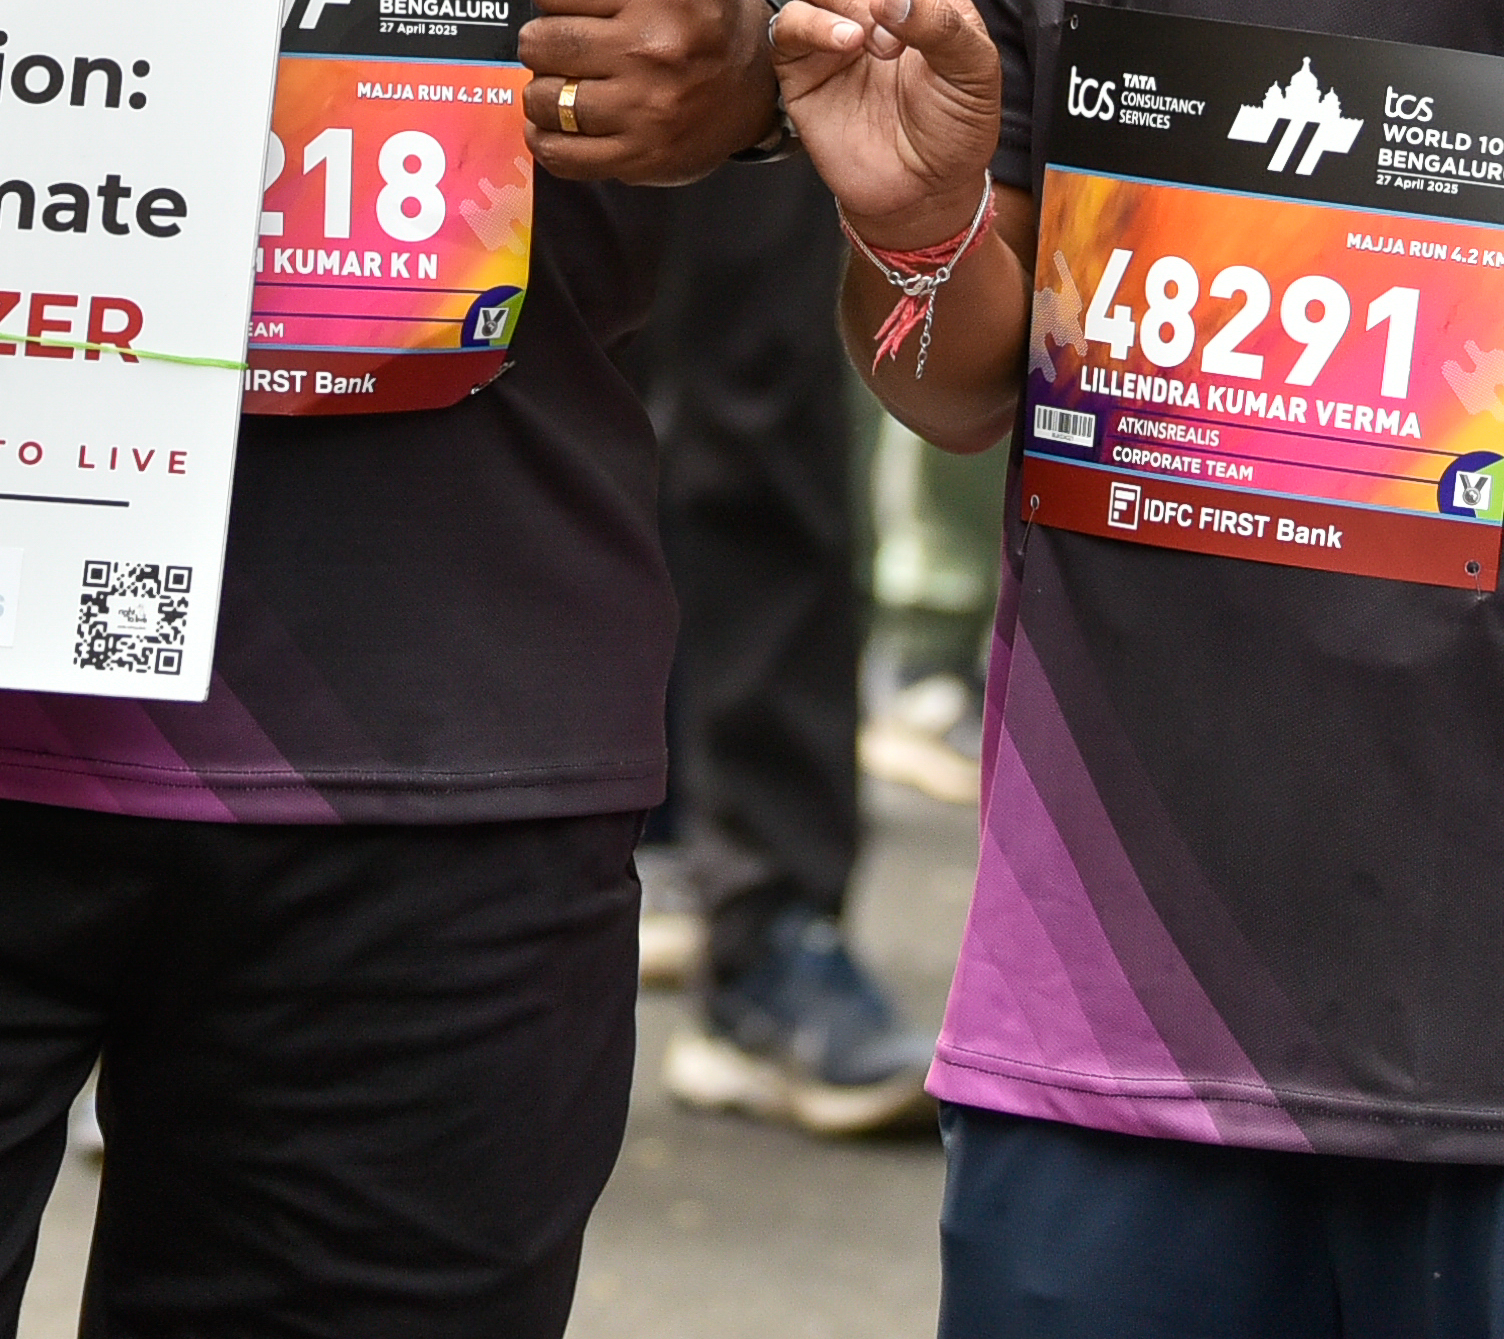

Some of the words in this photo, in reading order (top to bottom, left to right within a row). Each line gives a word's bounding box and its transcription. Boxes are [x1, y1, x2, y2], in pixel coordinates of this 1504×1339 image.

[379, 23, 394, 34] 27
[396, 23, 426, 37] April
[428, 24, 459, 36] 2025
[357, 82, 415, 101] MAJJA
[418, 84, 454, 102] RUN
[457, 85, 484, 104] 4.2
[486, 86, 513, 105] KM
[1067, 65, 1115, 122] tcs
[1123, 73, 1156, 91] TATA
[1120, 89, 1205, 116] CONSULTANCY
[1384, 85, 1435, 122] tcs
[1119, 109, 1171, 130] SERVICES
[1382, 122, 1472, 152] WORLD
[1376, 173, 1392, 186] 27
[1393, 175, 1424, 193] April
[1426, 180, 1459, 195] 2025
[1346, 231, 1406, 256] MAJJA
[1409, 240, 1448, 260] RUN
[1451, 245, 1479, 264] 4.2
[274, 248, 381, 277] KUMAR
[390, 252, 410, 278] K
[418, 254, 438, 279] N
[1084, 247, 1421, 400] 48291
[316, 372, 376, 394] Bank
[1080, 364, 1200, 407] LILLENDRA
[1207, 386, 1308, 423] KUMAR
[1315, 400, 1423, 439] VERMA
[1116, 415, 1220, 447] ATKINSREALIS
[77, 444, 189, 476] LIVE
[1112, 445, 1202, 475] CORPORATE
[1206, 459, 1254, 481] TEAM
[1143, 496, 1192, 527] IDFC
[1198, 507, 1270, 539] FIRST
[1276, 518, 1343, 549] Bank
